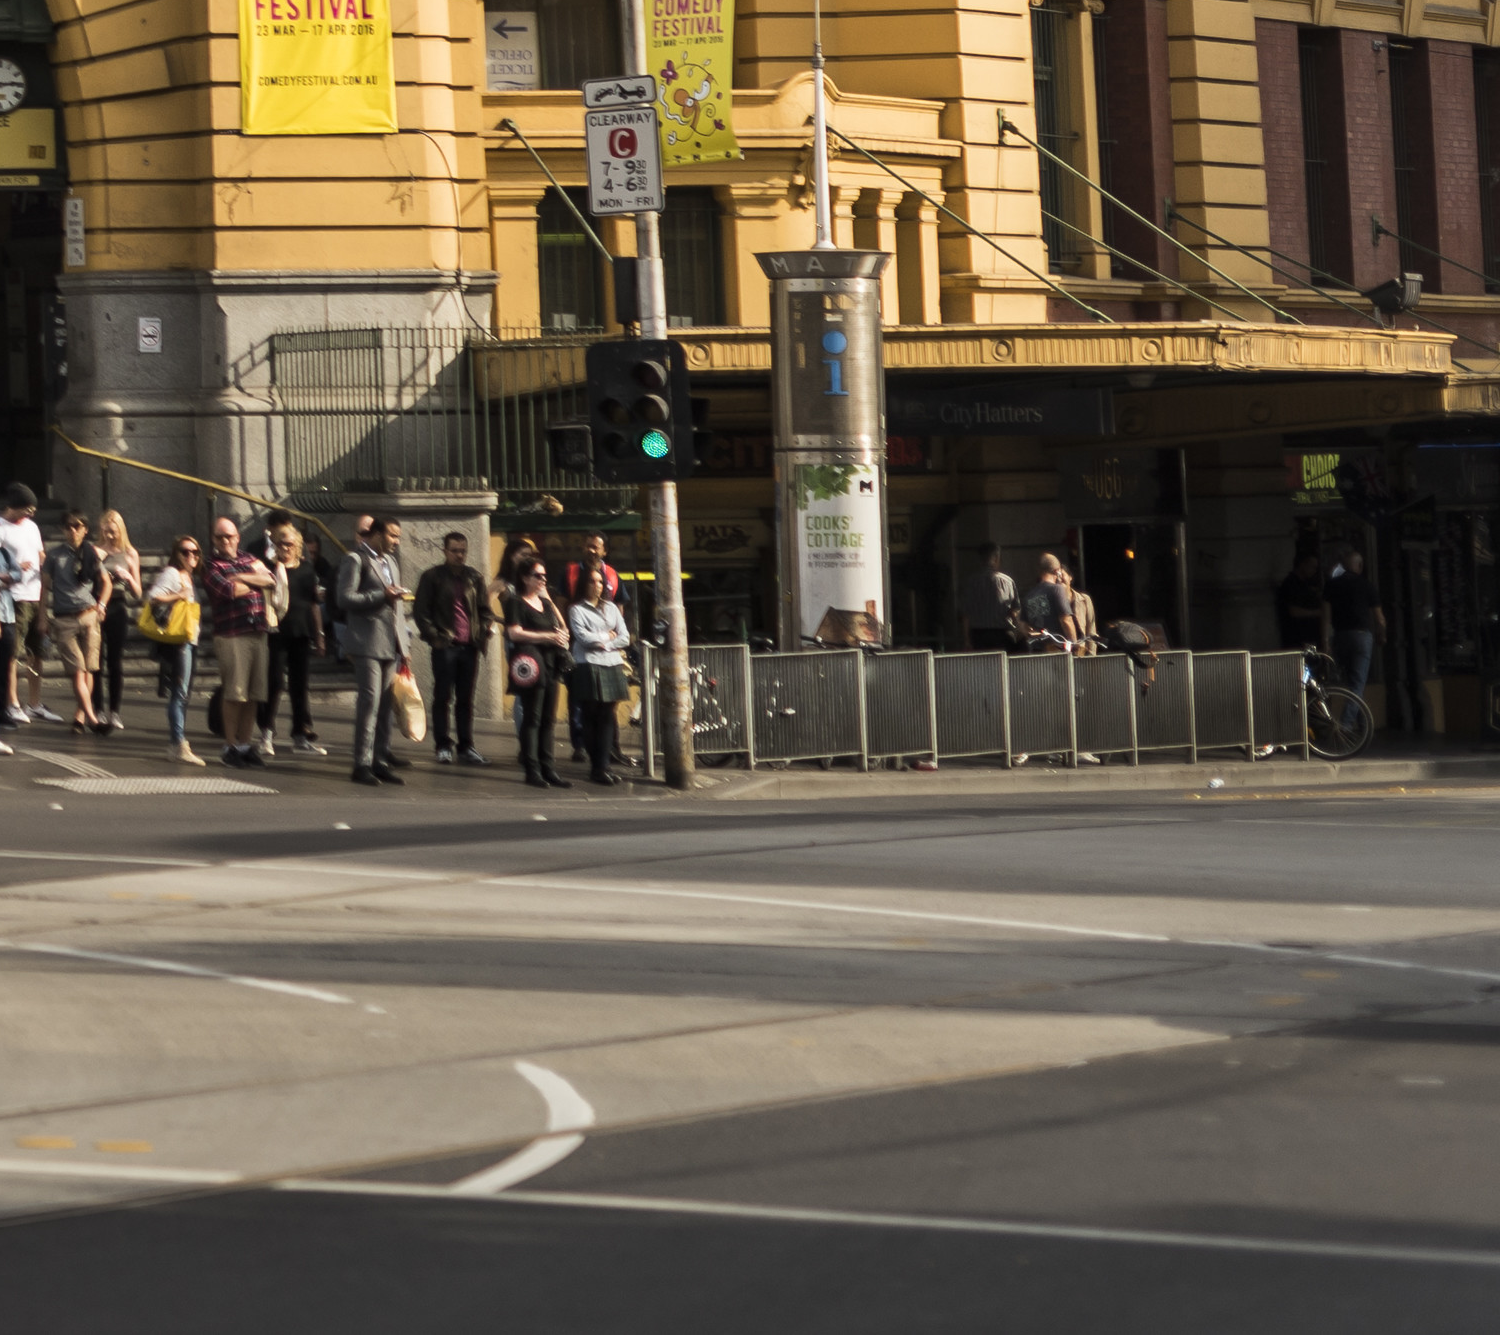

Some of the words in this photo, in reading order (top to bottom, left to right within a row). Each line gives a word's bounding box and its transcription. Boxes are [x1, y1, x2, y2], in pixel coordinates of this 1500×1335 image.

[256, 25, 269, 37] 23
[273, 25, 296, 37] MAR
[312, 24, 323, 36] 17
[327, 25, 347, 36] APR
[350, 24, 375, 36] 2016
[653, 16, 724, 38] FESTIVAL
[490, 49, 533, 61] OFFICE
[491, 64, 535, 75] TICKET
[258, 75, 378, 87] COMEDYFESTIVAL.COM.AU
[589, 113, 652, 127] CLEARWAY
[613, 130, 631, 156] C
[600, 199, 623, 208] MON
[636, 197, 654, 206] FRI
[807, 533, 865, 547] COTTAGE
